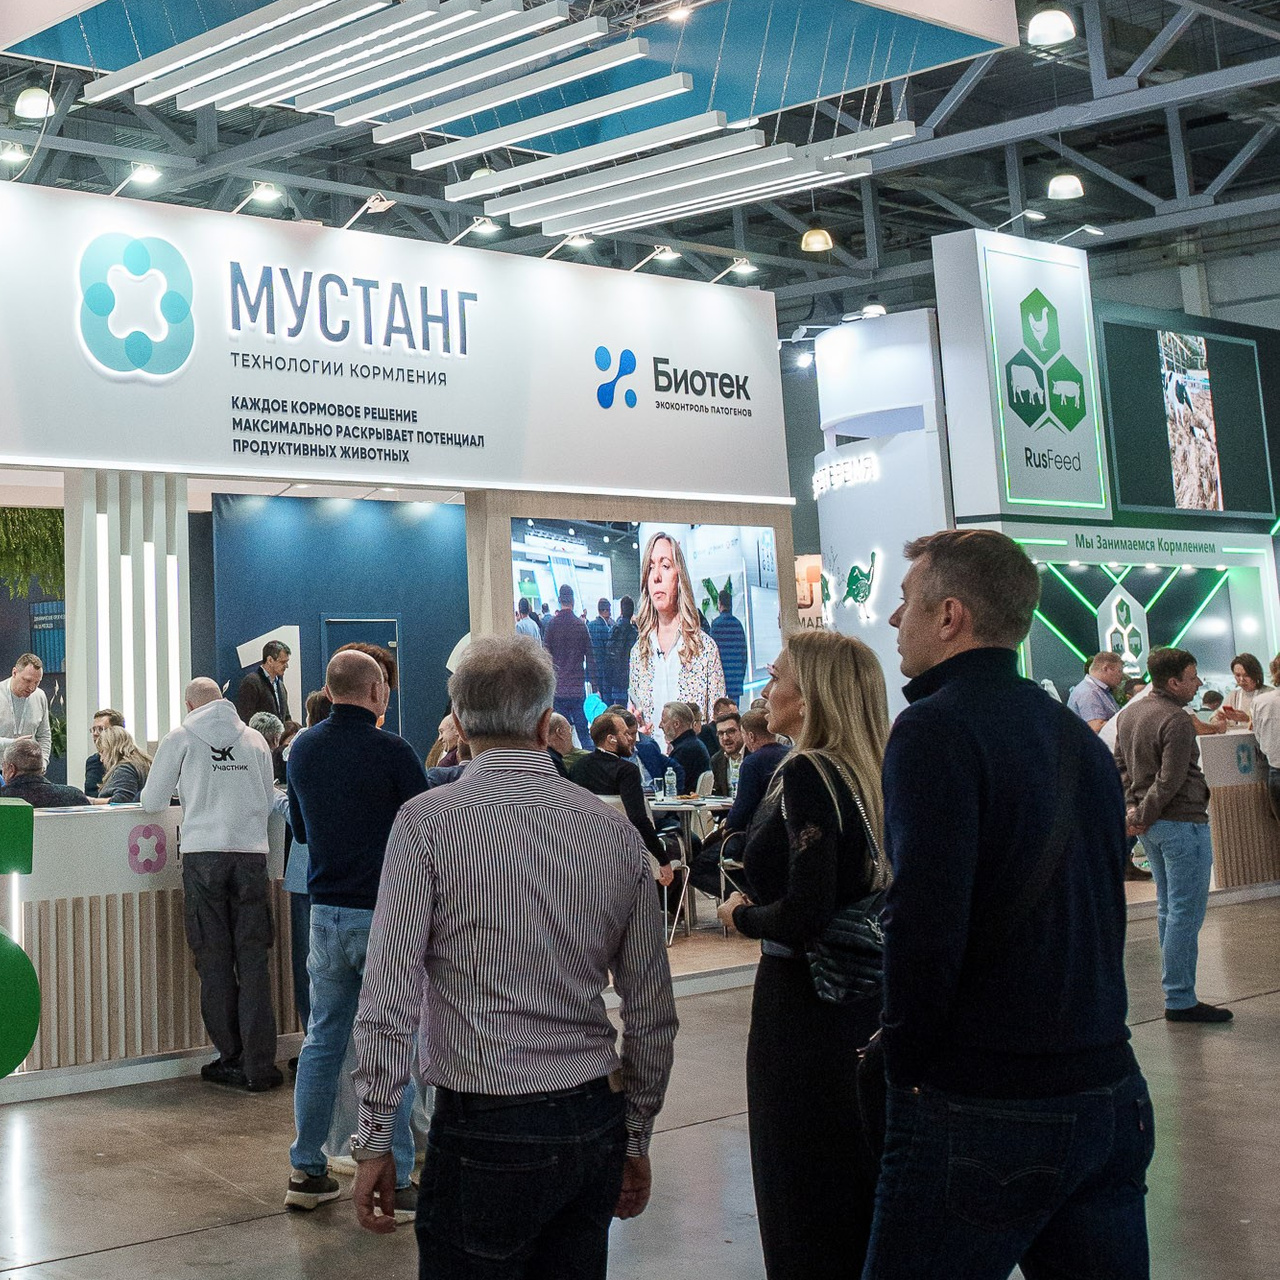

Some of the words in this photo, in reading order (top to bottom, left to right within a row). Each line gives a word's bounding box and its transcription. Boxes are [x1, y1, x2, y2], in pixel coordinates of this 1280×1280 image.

[230, 261, 478, 355] МУСТАНГ
[231, 352, 344, 376] ТЕХНОЛОГИИ
[350, 363, 448, 387] КОРМЛЕНИЯ
[653, 356, 751, 401] Биотек
[231, 396, 288, 414] КАЖДОЕ
[291, 401, 361, 419] КОРМОВОЕ
[364, 406, 418, 423] РЕШЕНИЕ
[655, 400, 709, 413] ЭКОКОНТРОЛЬ
[710, 405, 752, 417] ПАТОГЕНОВ
[232, 418, 333, 438] МАКСИМАЛЬНО
[336, 424, 414, 443] РАСКРЫВАЕТ
[417, 431, 485, 449] ПОТЕНЦИАЛ
[233, 439, 337, 458] ПРОДУКТИВНЫХ
[340, 445, 410, 463] ЖИВОТНЫХ
[1024, 446, 1082, 471] RusFeed
[1075, 533, 1094, 549] Мы
[1096, 534, 1156, 551] Занимаемся
[1157, 538, 1216, 555] Кормлением
[212, 764, 248, 772] Участник
